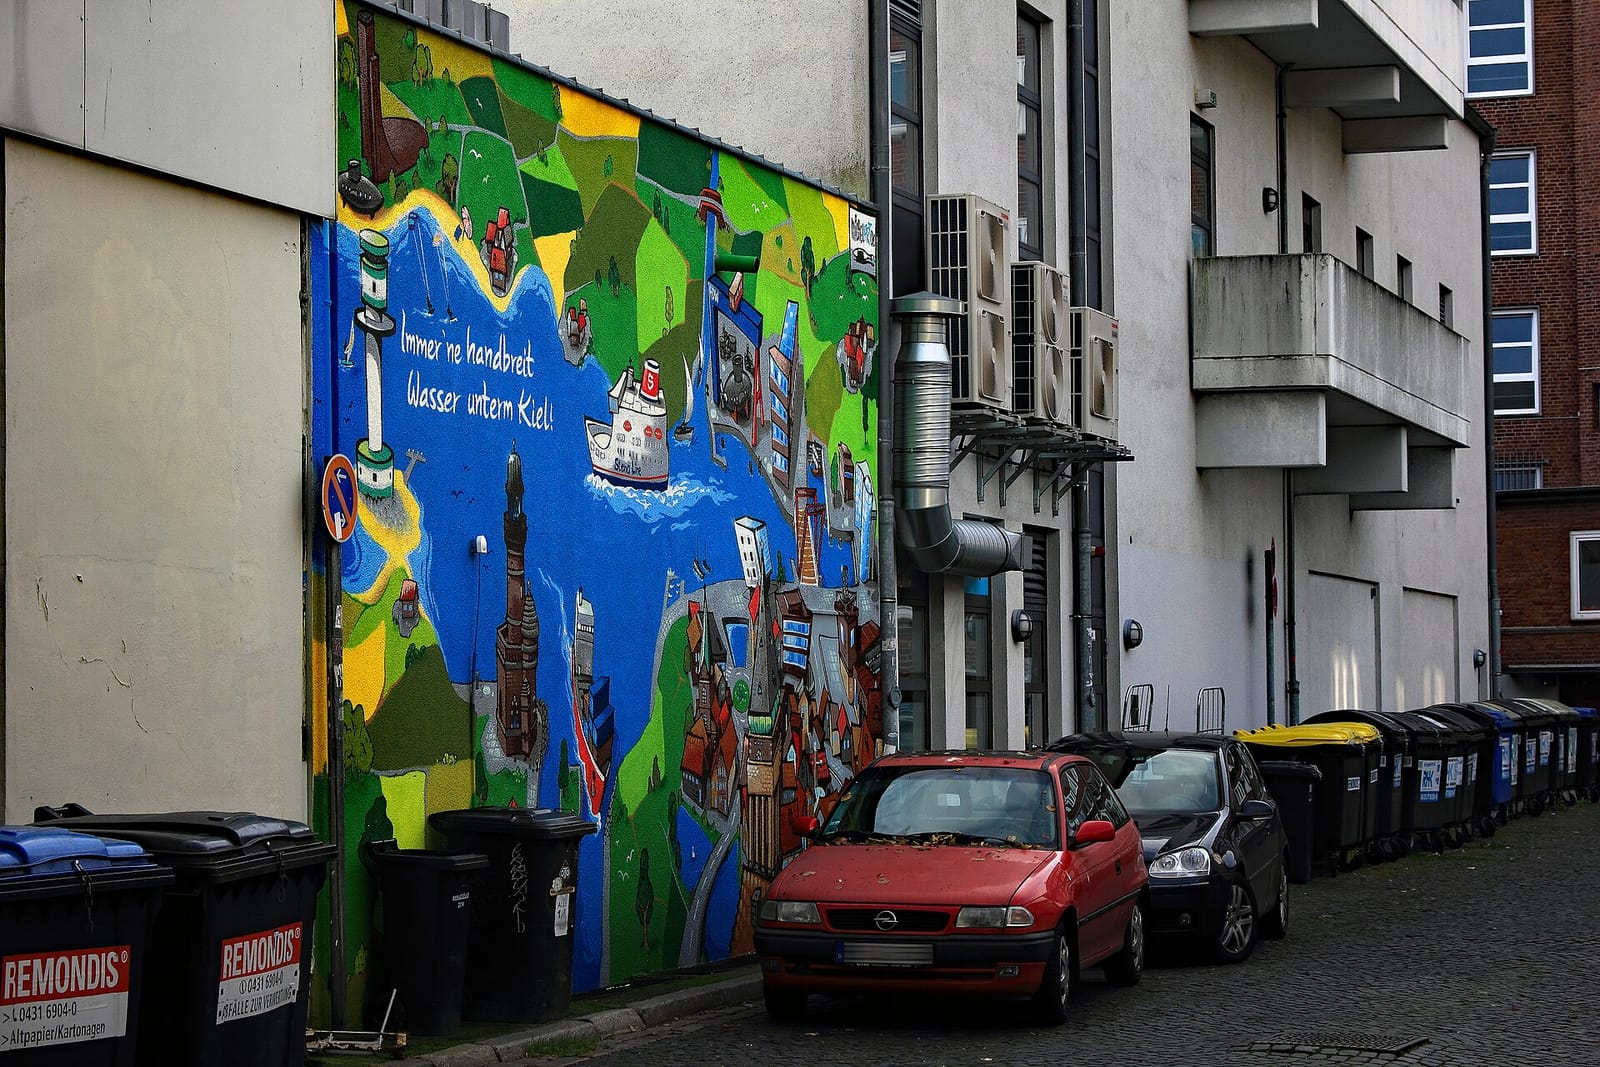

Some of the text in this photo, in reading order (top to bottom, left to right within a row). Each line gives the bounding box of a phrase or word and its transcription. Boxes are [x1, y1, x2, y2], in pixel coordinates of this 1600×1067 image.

[401, 308, 442, 361] Immer
[466, 325, 535, 378] handbreit
[407, 369, 554, 431] Wasser unterm Kiel!
[4, 951, 119, 999] REMONDIS
[223, 929, 294, 979] REMONDIS
[247, 976, 264, 993] 0431
[10, 1022, 106, 1047] Altpapier/Kartonagen
[19, 1001, 77, 1022] 0431 6904-0
